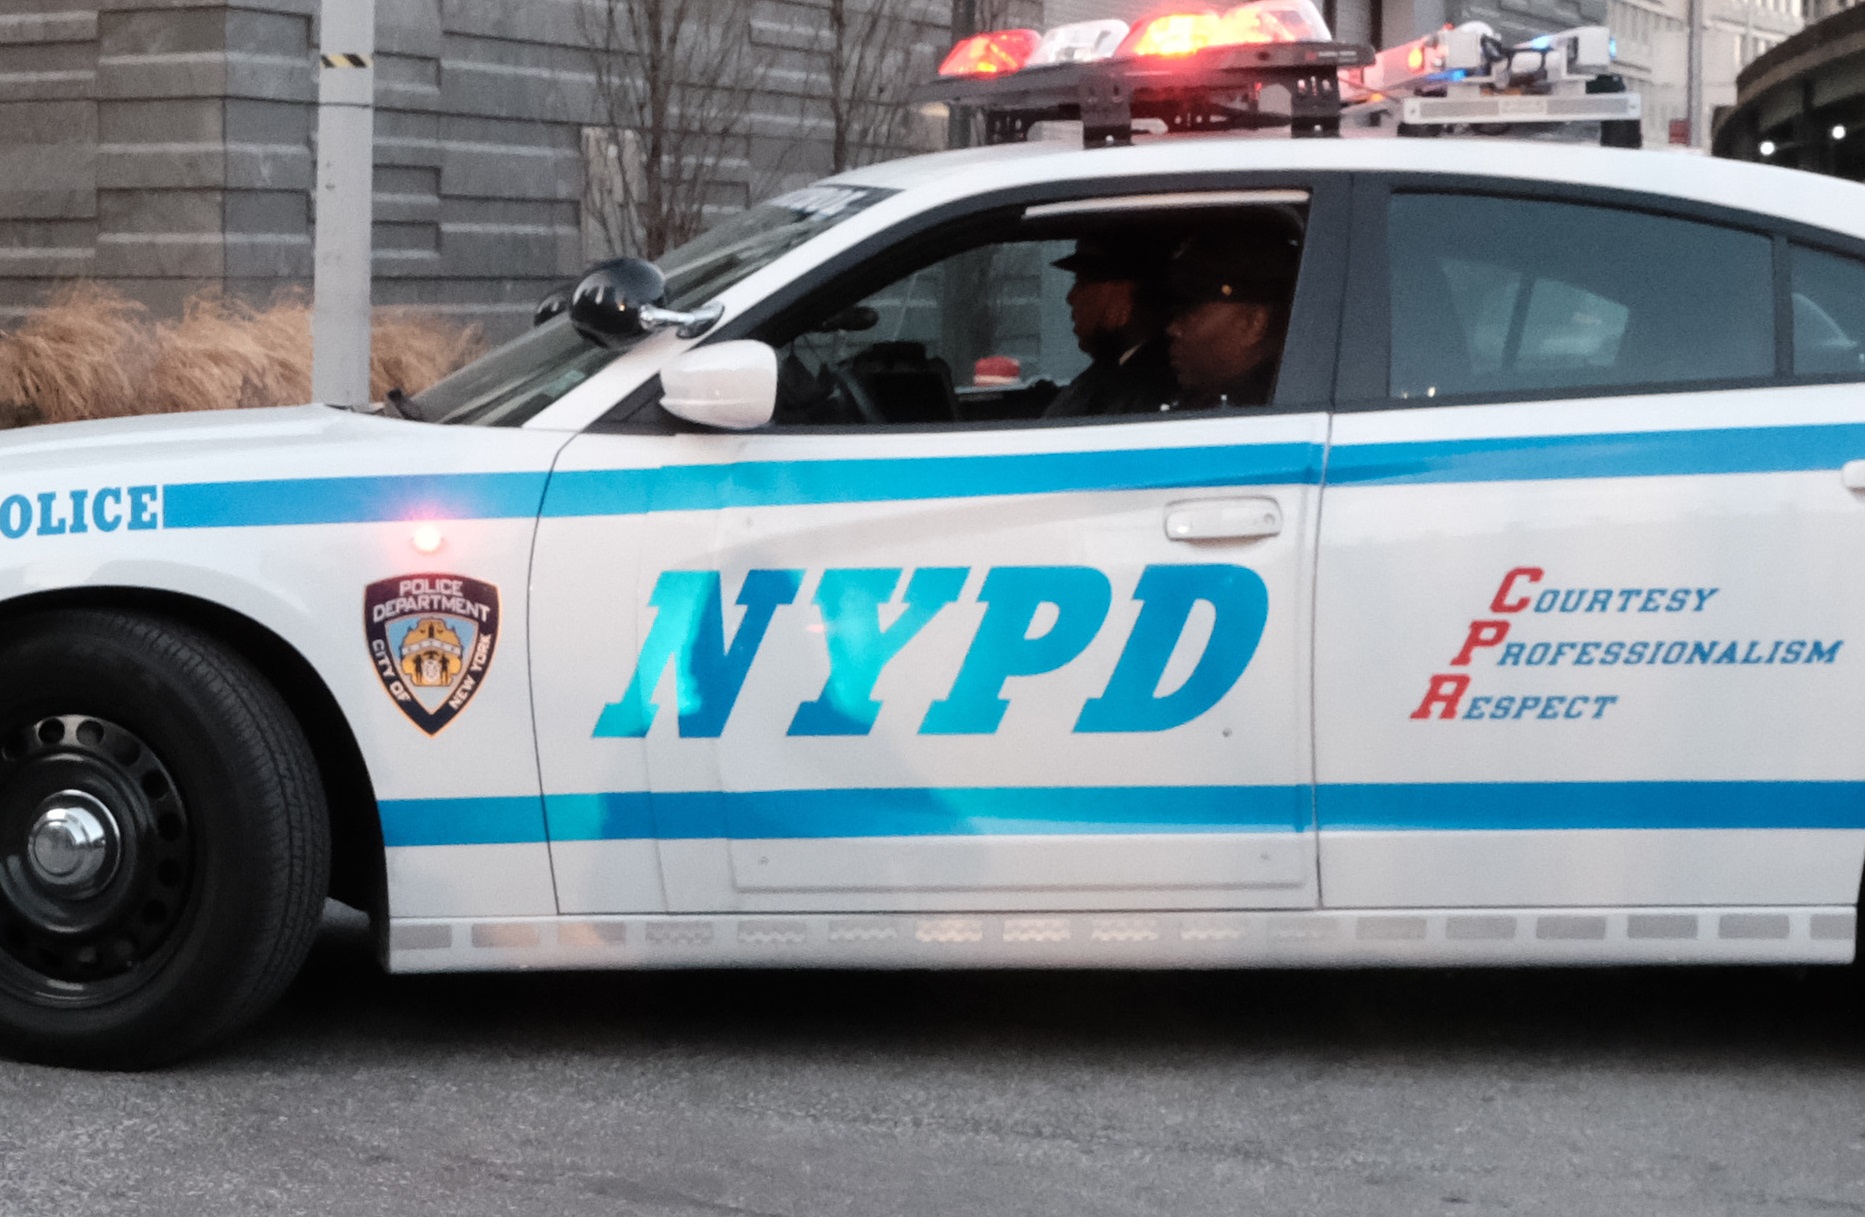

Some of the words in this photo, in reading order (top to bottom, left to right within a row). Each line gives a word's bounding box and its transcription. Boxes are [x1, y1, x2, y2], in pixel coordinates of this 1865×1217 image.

[0, 485, 157, 539] OLICE
[373, 595, 490, 623] DEPARTMENT
[400, 579, 463, 597] POLICE
[1489, 566, 1719, 613] COURTESY
[591, 563, 1269, 738] NYPD
[1450, 620, 1844, 666] PROFESSIONALISM
[372, 639, 395, 677] CITY
[390, 681, 412, 701] OF
[449, 675, 476, 709] NEW
[471, 633, 492, 672] YORK
[1409, 673, 1619, 719] RESPECT
